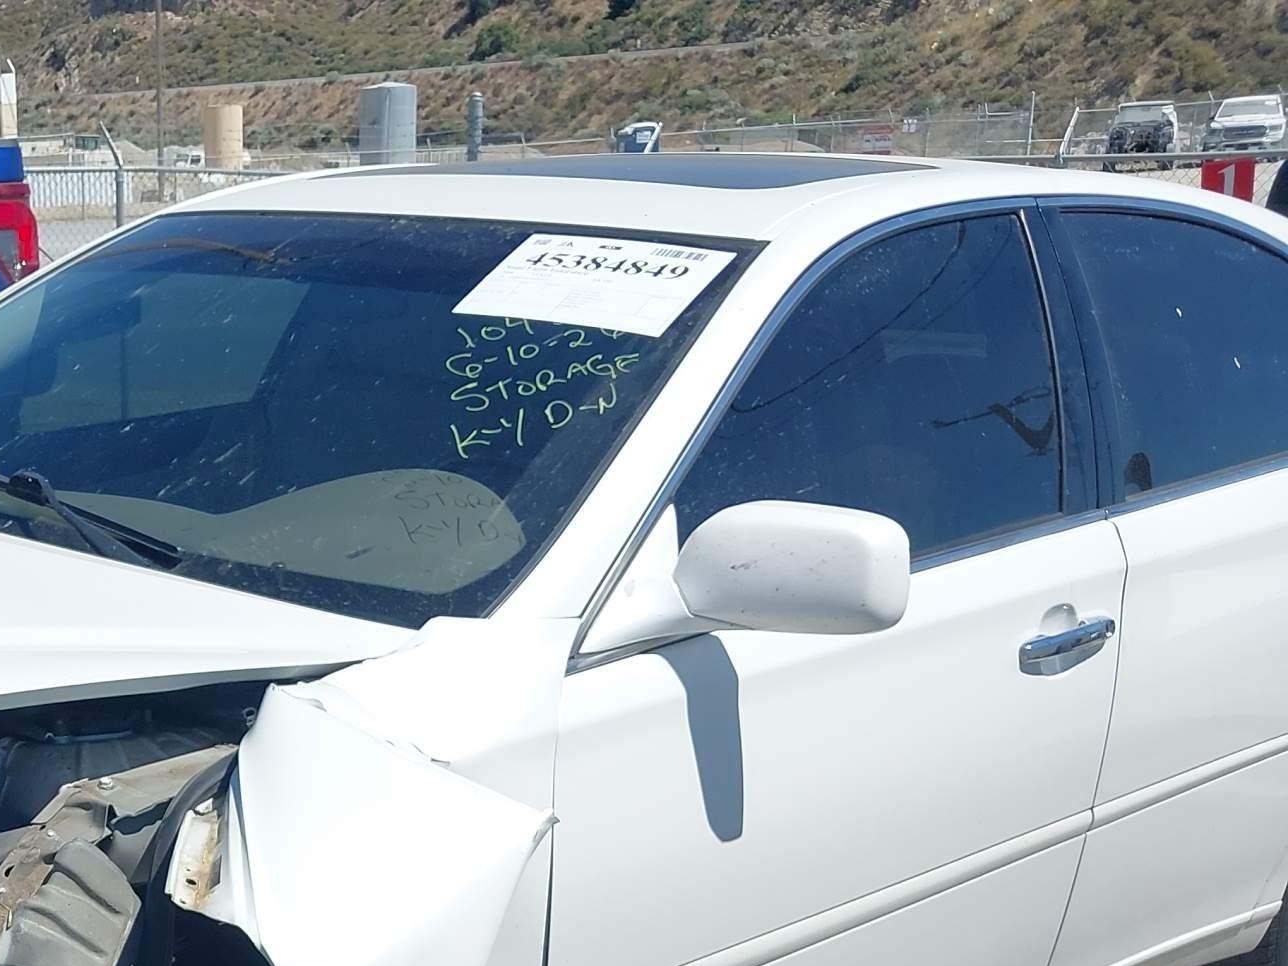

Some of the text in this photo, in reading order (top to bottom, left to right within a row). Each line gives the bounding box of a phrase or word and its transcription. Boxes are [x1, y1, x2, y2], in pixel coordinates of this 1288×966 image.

[1217, 164, 1236, 197] 1
[525, 251, 691, 280] 45384849
[449, 353, 640, 412] STORAGE
